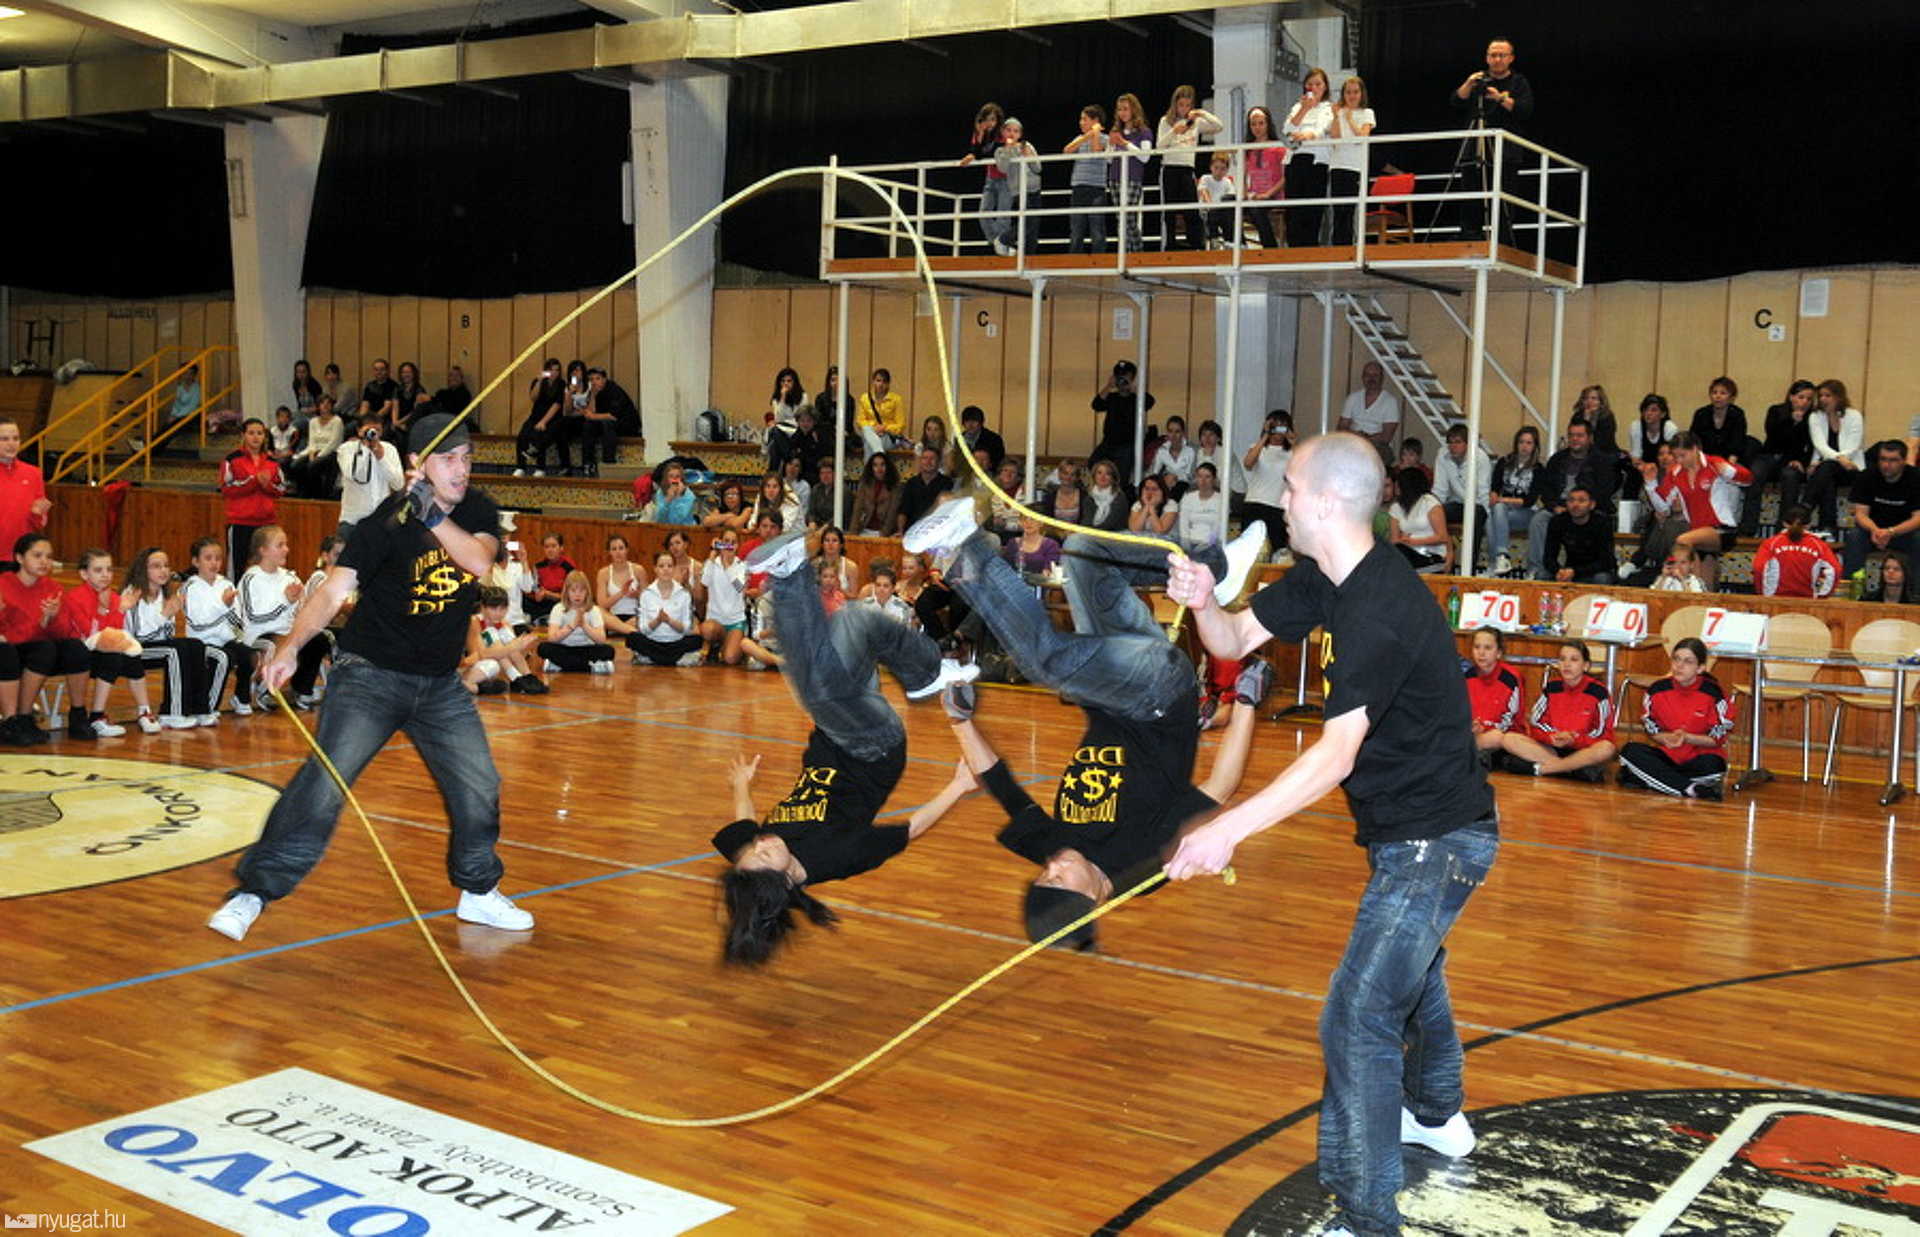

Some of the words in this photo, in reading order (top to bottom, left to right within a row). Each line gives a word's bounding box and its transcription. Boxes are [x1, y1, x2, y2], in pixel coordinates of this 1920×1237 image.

[462, 315, 470, 328] B
[977, 311, 989, 327] C
[1754, 308, 1772, 329] C
[1592, 602, 1607, 624] 7
[1623, 608, 1640, 631] 0
[1706, 611, 1723, 636] 7
[1074, 746, 1127, 767] DD
[218, 1108, 390, 1160] AUTÓ
[369, 1156, 595, 1232] ALPOK
